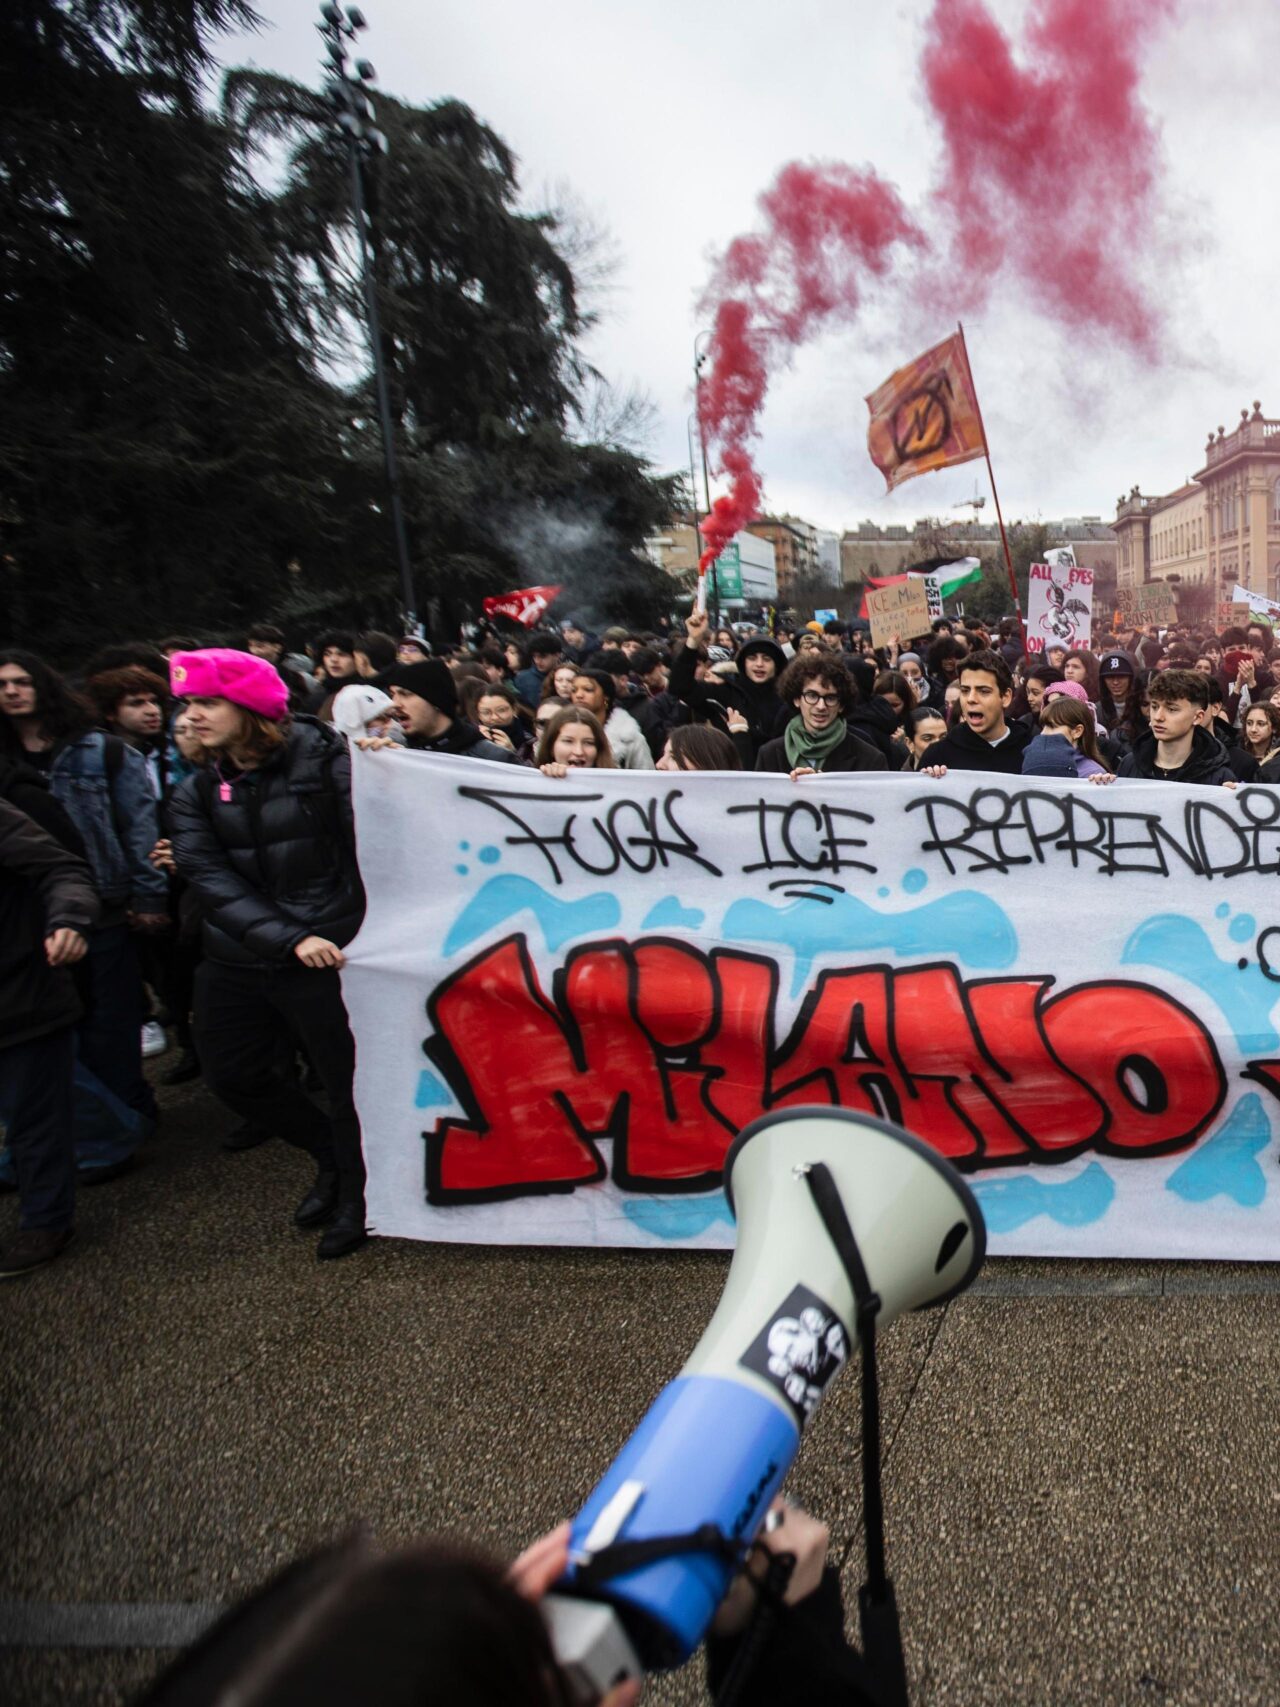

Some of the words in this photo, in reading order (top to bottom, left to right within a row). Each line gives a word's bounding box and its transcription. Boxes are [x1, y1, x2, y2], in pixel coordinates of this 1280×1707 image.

[1031, 565, 1052, 581] ALL
[1069, 568, 1093, 585] EYES
[869, 591, 890, 614] ICE
[1154, 608, 1169, 623] ICE
[1027, 636, 1045, 652] ON
[727, 798, 878, 875] ICE
[423, 931, 1229, 1207] MILANO
